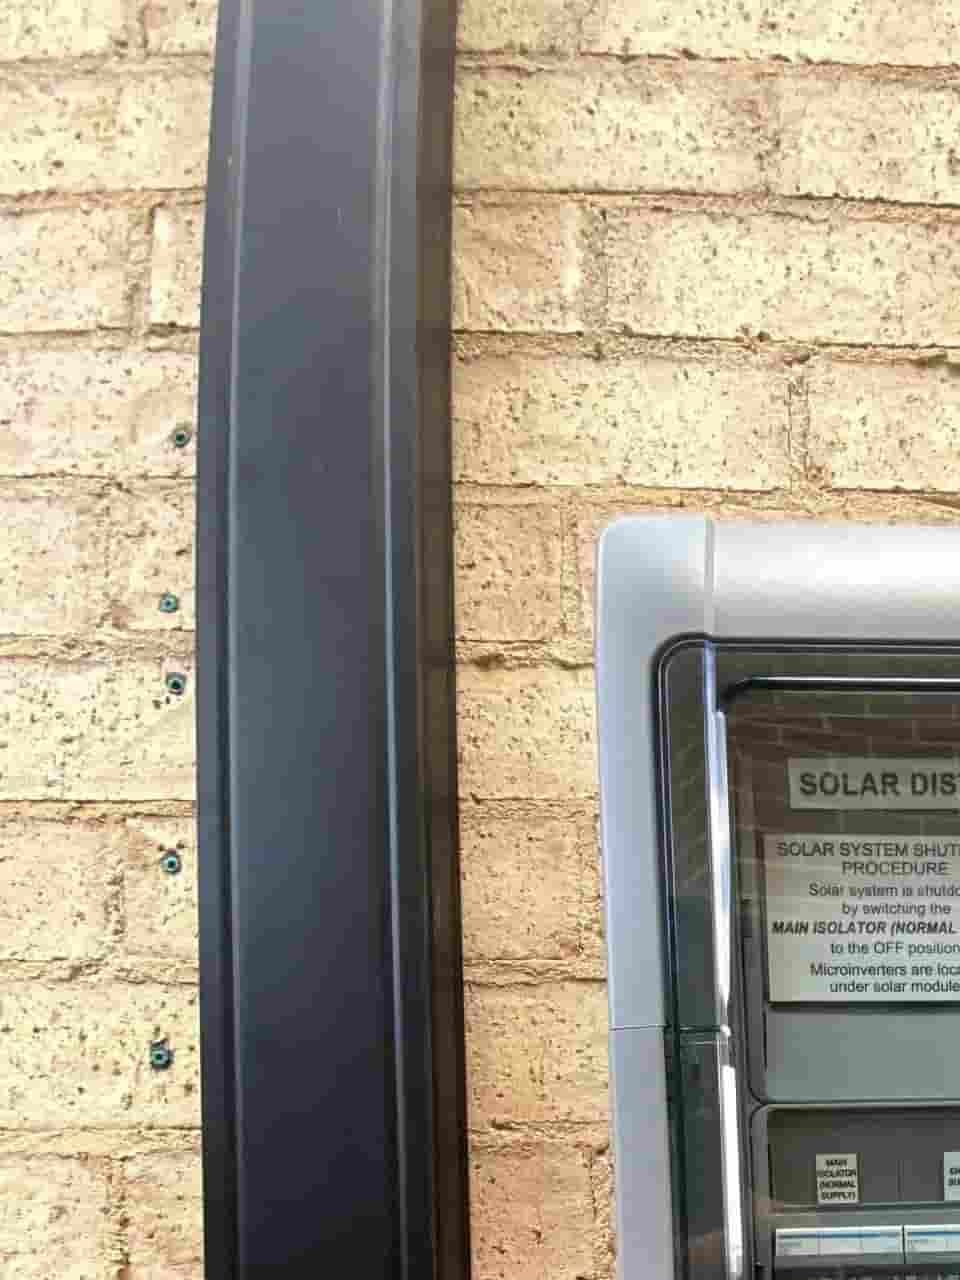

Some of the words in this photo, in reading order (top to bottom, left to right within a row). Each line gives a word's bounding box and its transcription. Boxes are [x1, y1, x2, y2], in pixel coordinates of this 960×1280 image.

[800, 771, 899, 796] SOLAR
[777, 842, 835, 857] SOLAR
[839, 842, 908, 858] SYSTEM
[842, 861, 949, 876] PROCEDURE
[808, 882, 844, 897] Solar
[850, 884, 897, 900] system
[902, 883, 913, 897] is
[842, 902, 857, 916] by
[862, 902, 926, 917] switching
[930, 902, 951, 915] the
[772, 921, 809, 935] MAIN
[813, 921, 886, 935] ISOLATOR
[890, 921, 955, 937] (NORMAL
[830, 942, 843, 954] to
[847, 941, 870, 954] the
[873, 941, 904, 954] OFF
[908, 941, 960, 958] position
[810, 962, 906, 977] Microinverters
[911, 965, 933, 977] are
[829, 980, 869, 994] under
[873, 980, 906, 993] solar
